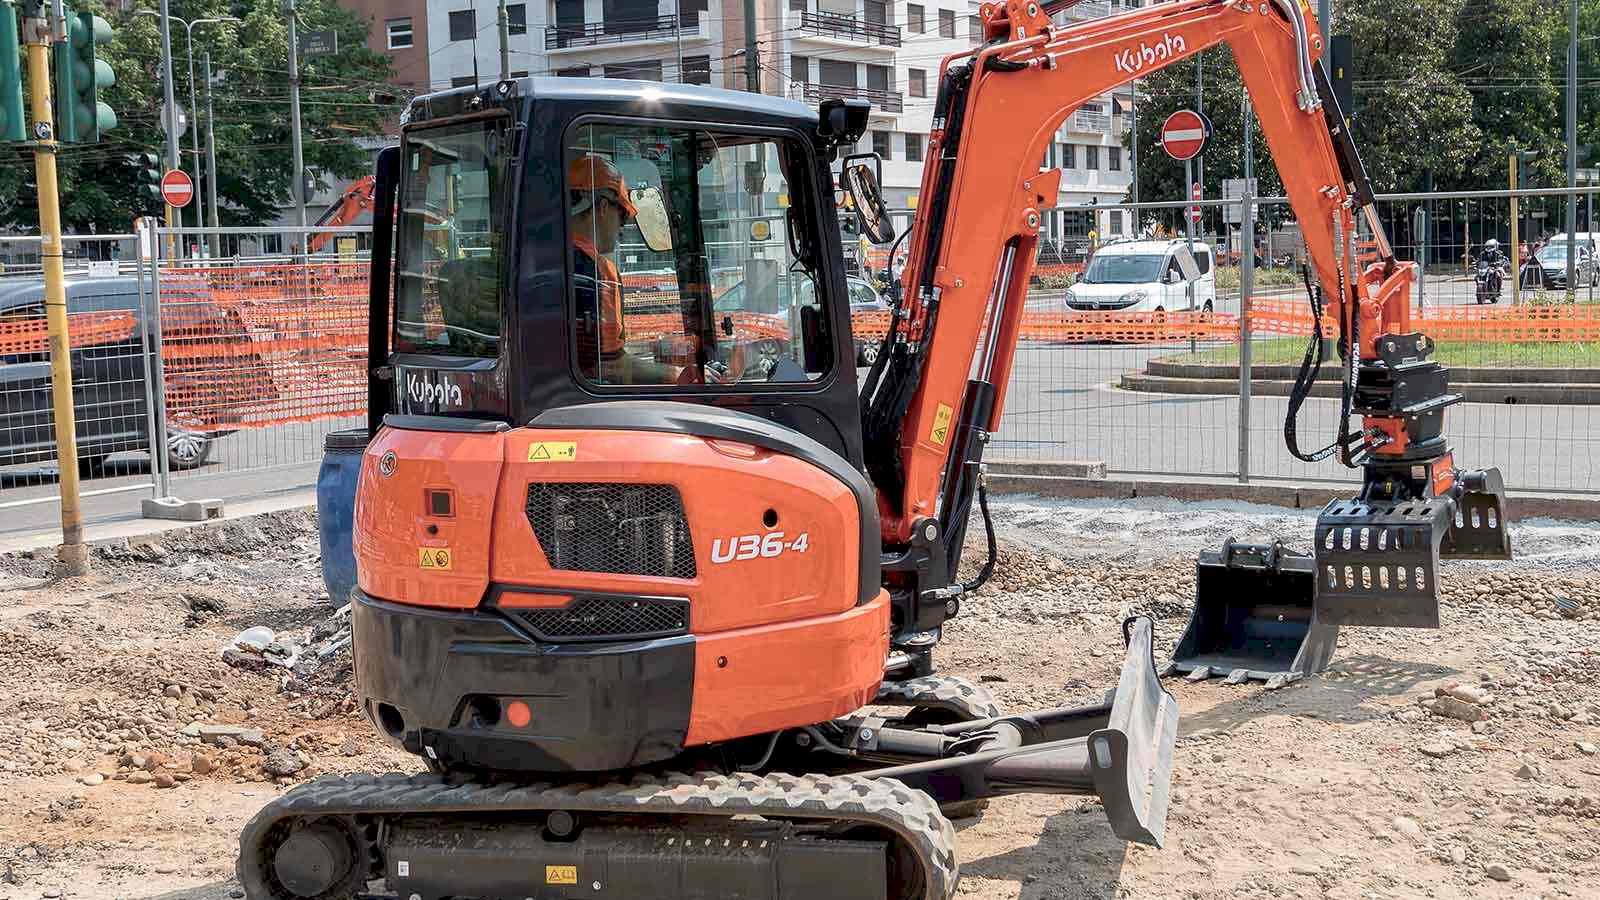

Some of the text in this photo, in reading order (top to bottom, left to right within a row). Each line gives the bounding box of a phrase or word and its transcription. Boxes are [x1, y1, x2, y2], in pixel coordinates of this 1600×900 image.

[1113, 32, 1186, 73] Kubota
[406, 372, 463, 406] Kubota
[711, 531, 809, 564] U36-4
